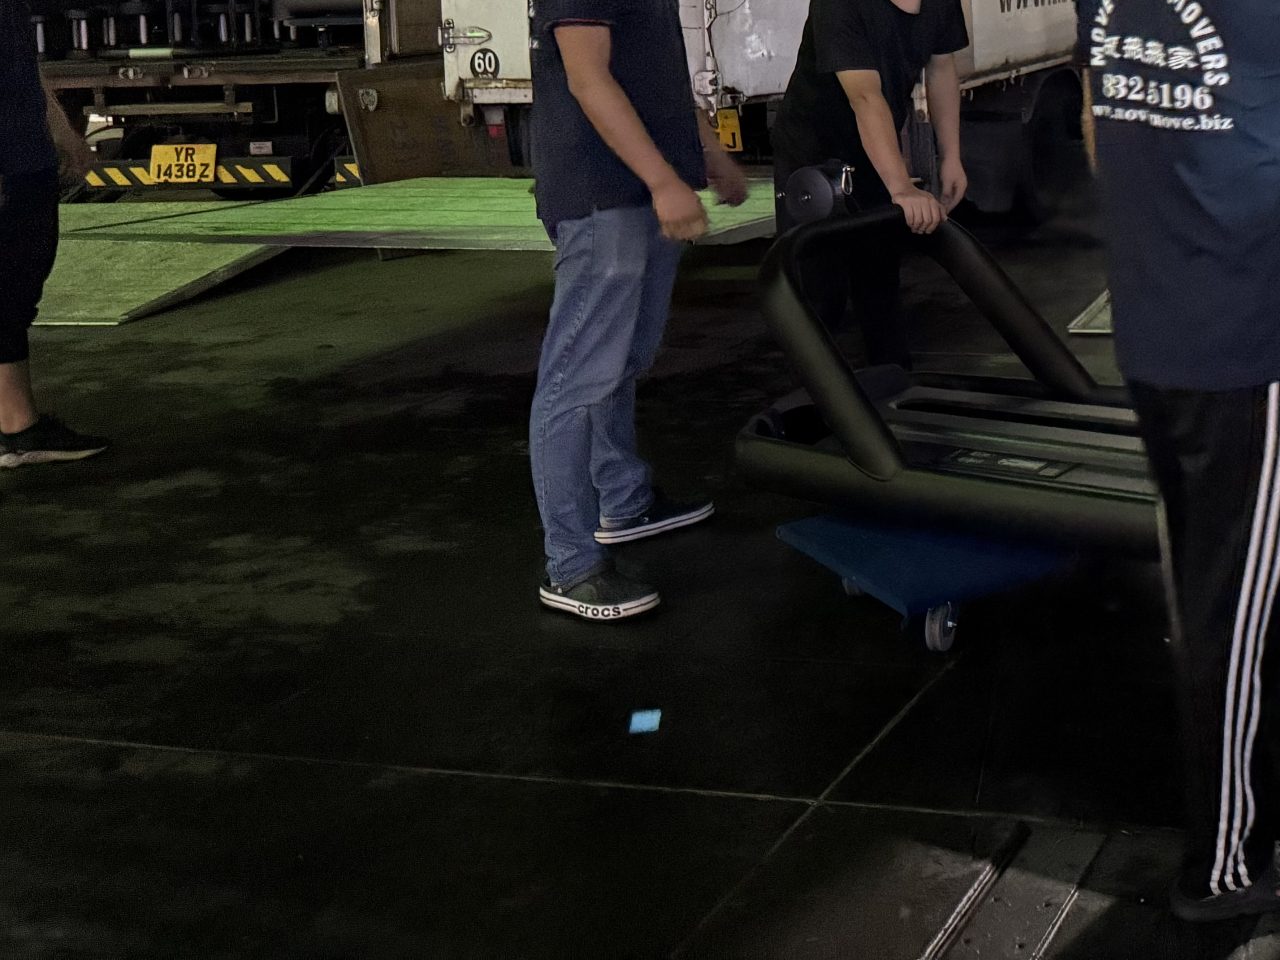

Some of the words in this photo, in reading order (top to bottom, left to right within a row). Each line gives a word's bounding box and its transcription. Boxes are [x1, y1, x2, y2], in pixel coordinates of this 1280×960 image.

[474, 52, 495, 73] 60
[175, 147, 195, 162] YR
[577, 604, 621, 617] crocs
